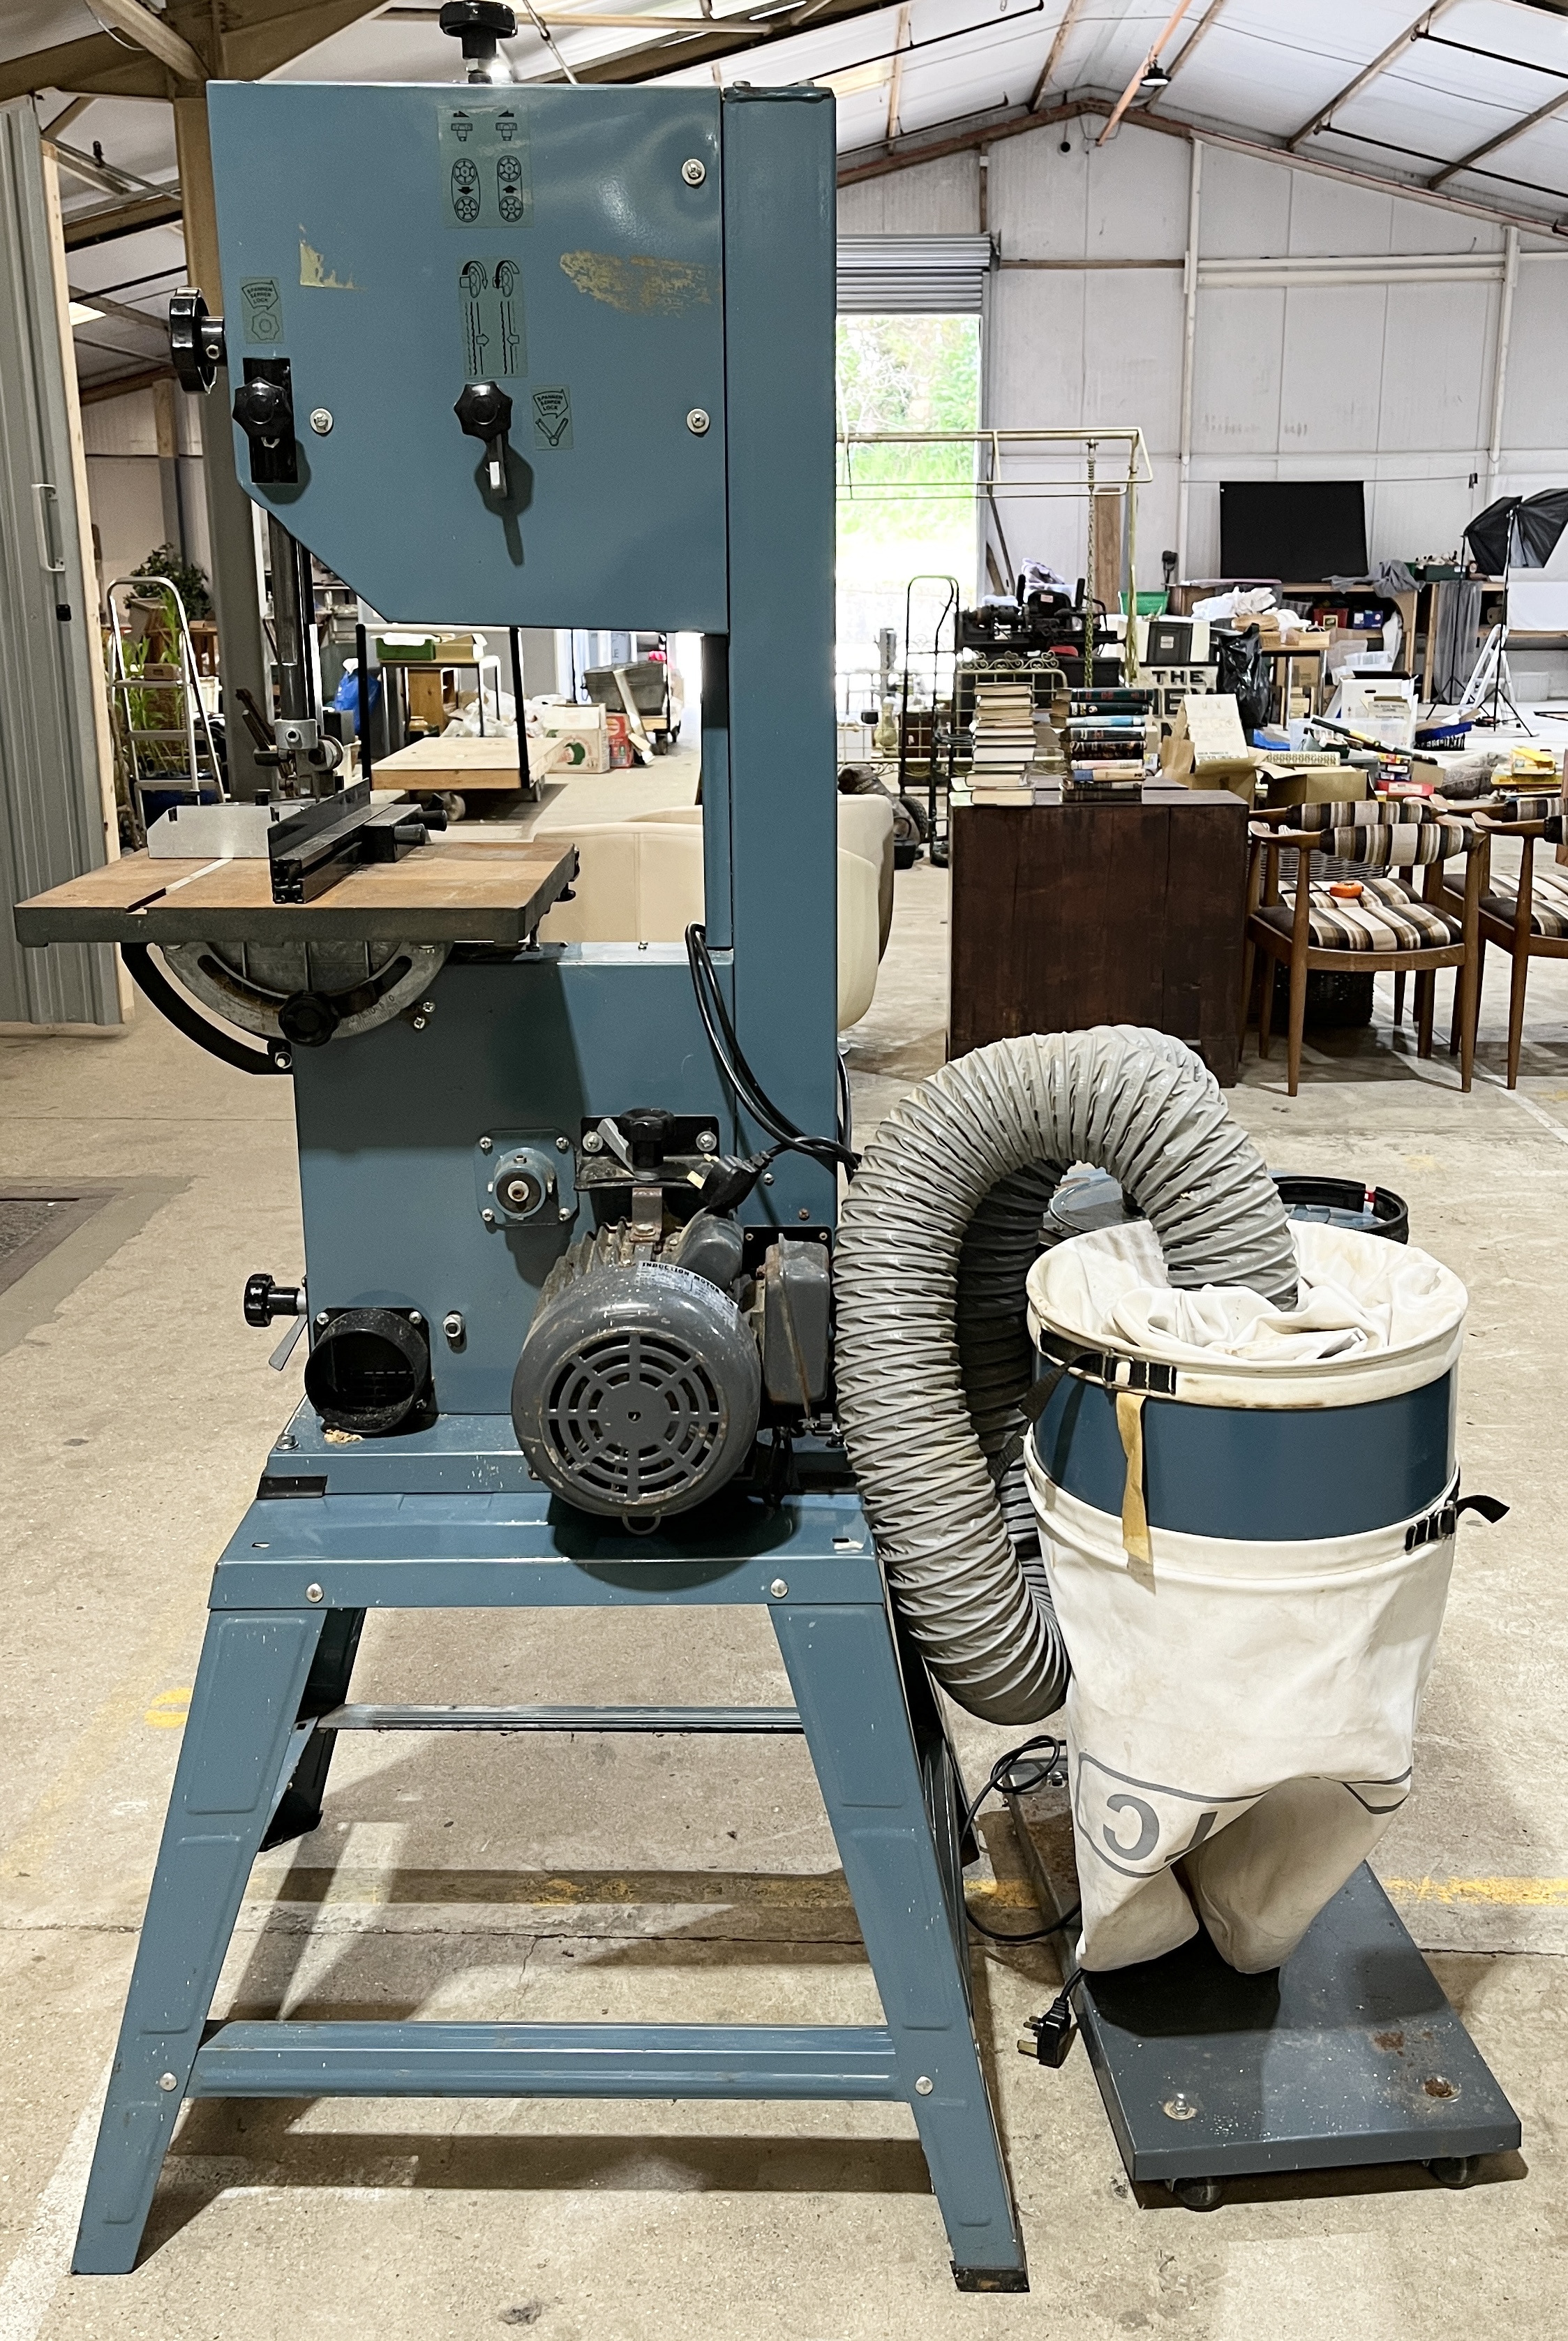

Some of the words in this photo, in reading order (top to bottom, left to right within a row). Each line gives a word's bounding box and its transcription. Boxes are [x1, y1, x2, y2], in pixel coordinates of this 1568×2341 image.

[1152, 670, 1206, 685] THE
[388, 995, 395, 1003] 0
[642, 1262, 689, 1276] INDUCTION
[694, 1275, 720, 1295] MOTOR
